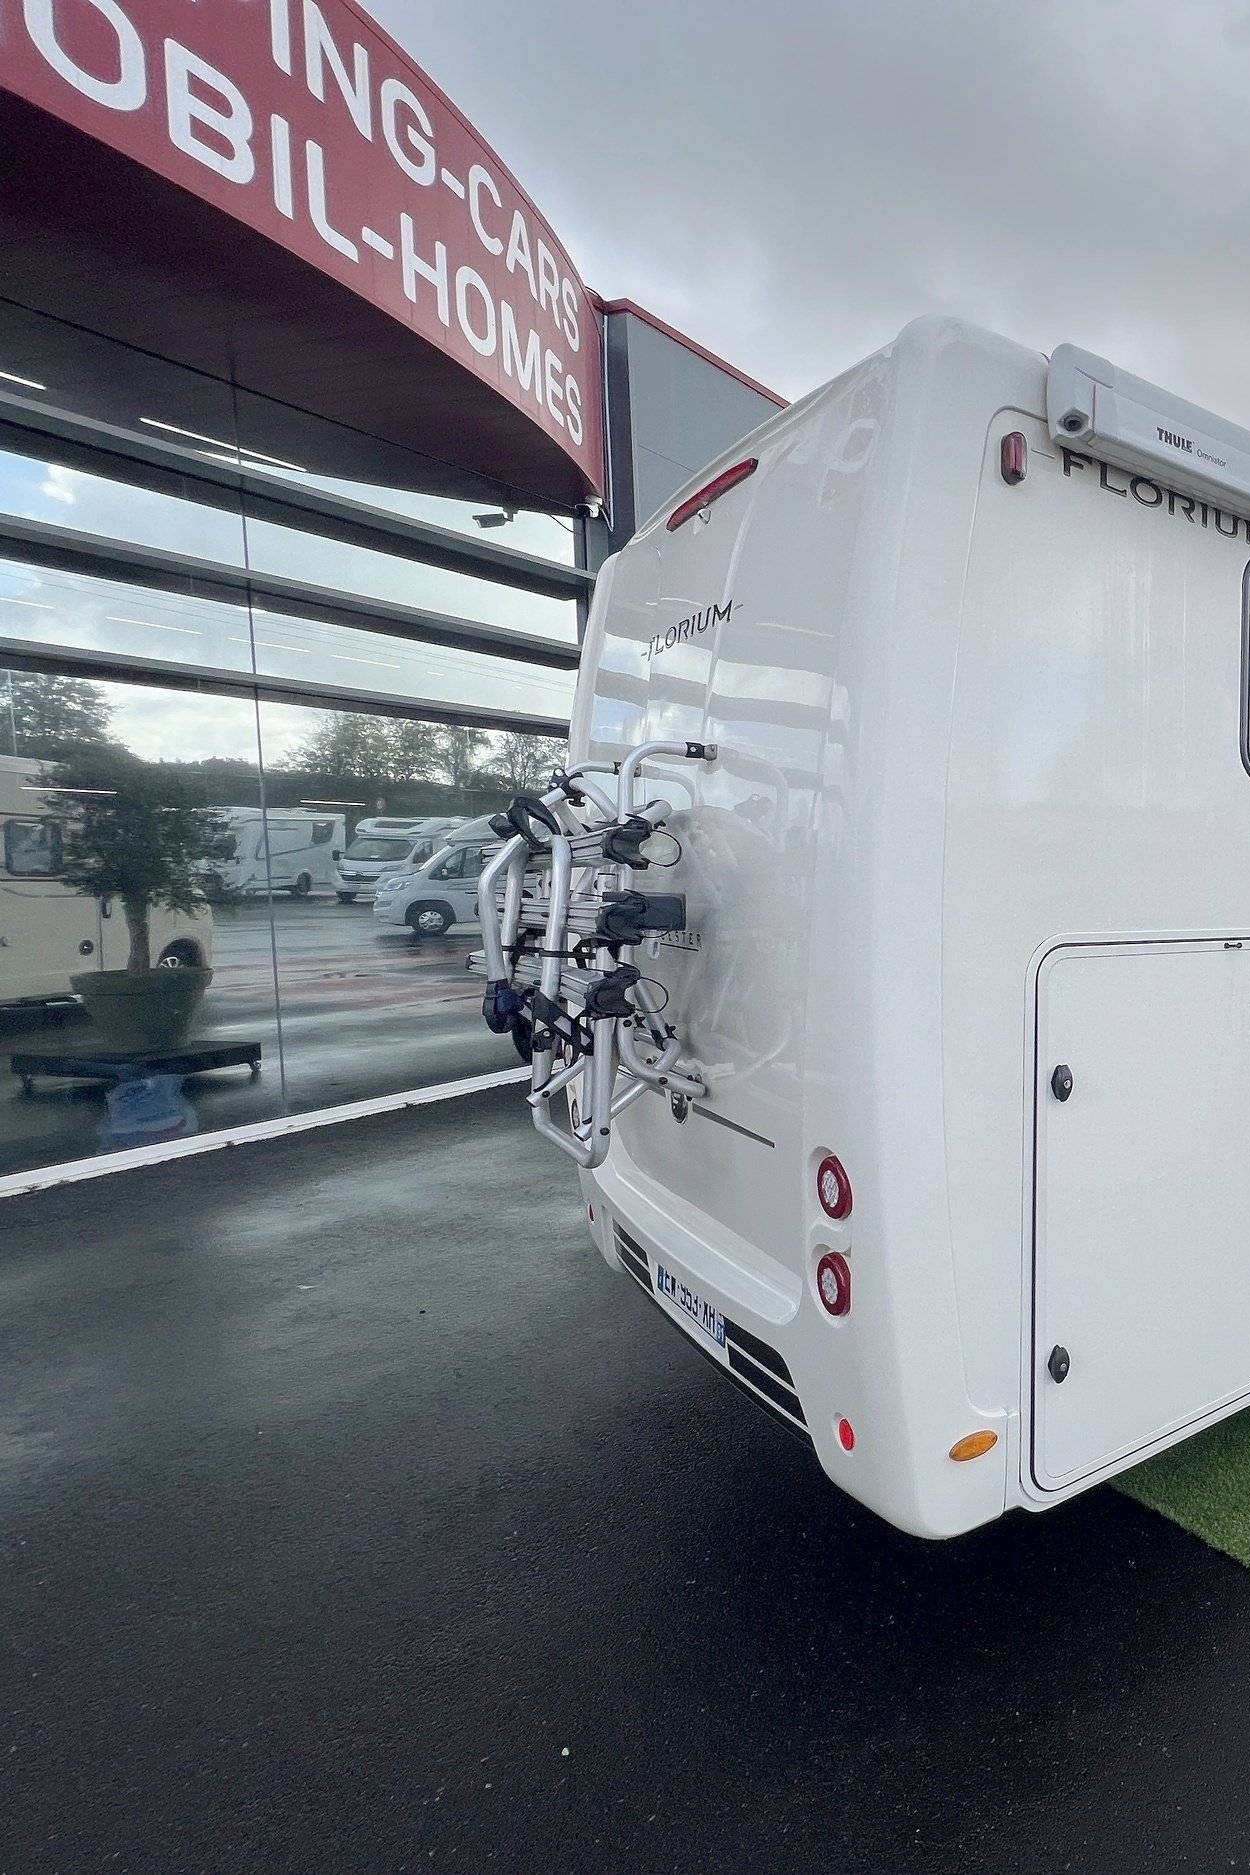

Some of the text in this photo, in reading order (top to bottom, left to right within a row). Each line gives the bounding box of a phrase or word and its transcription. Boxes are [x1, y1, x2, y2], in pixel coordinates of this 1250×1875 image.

[190, 0, 580, 352] ING-CARS
[1156, 426, 1193, 454] THULE
[647, 599, 733, 661] FLORIUM
